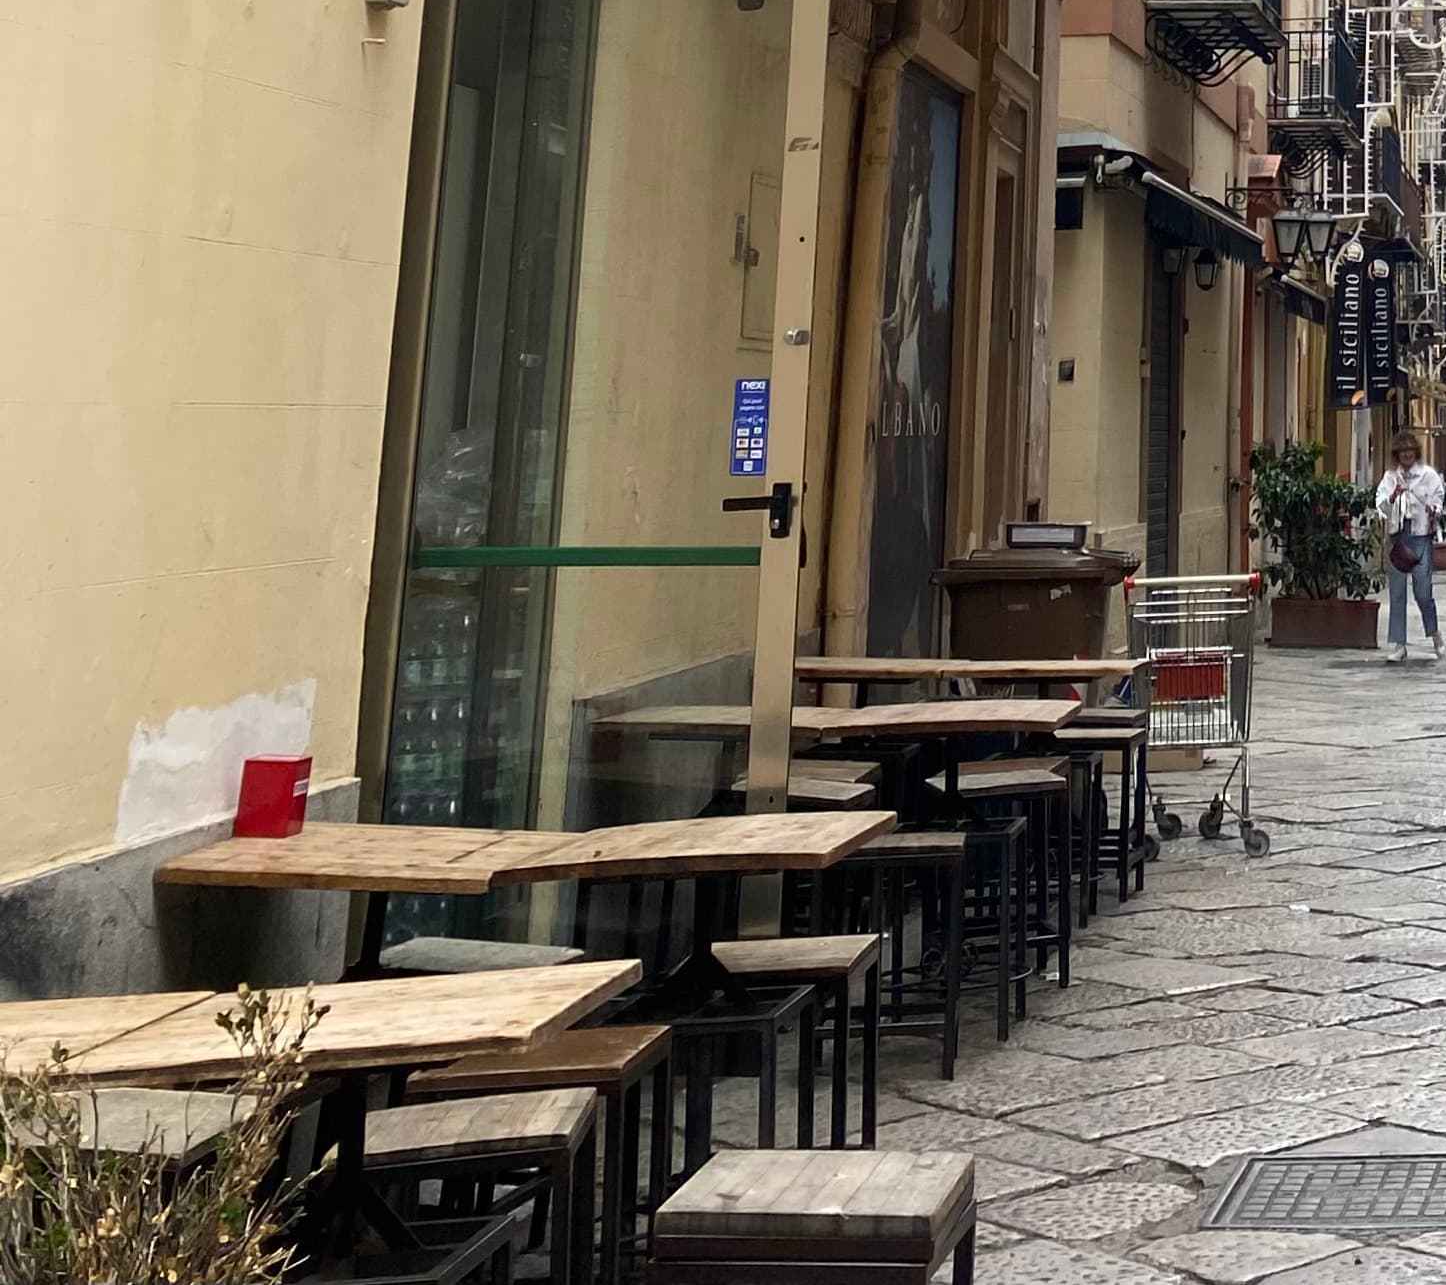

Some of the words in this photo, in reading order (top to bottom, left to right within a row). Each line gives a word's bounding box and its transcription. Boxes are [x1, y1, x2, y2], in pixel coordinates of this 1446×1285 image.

[1338, 274, 1360, 367] siciliano
[1370, 288, 1389, 368] siciliano
[741, 381, 766, 391] nexi
[1336, 376, 1356, 390] il
[1371, 376, 1389, 388] il
